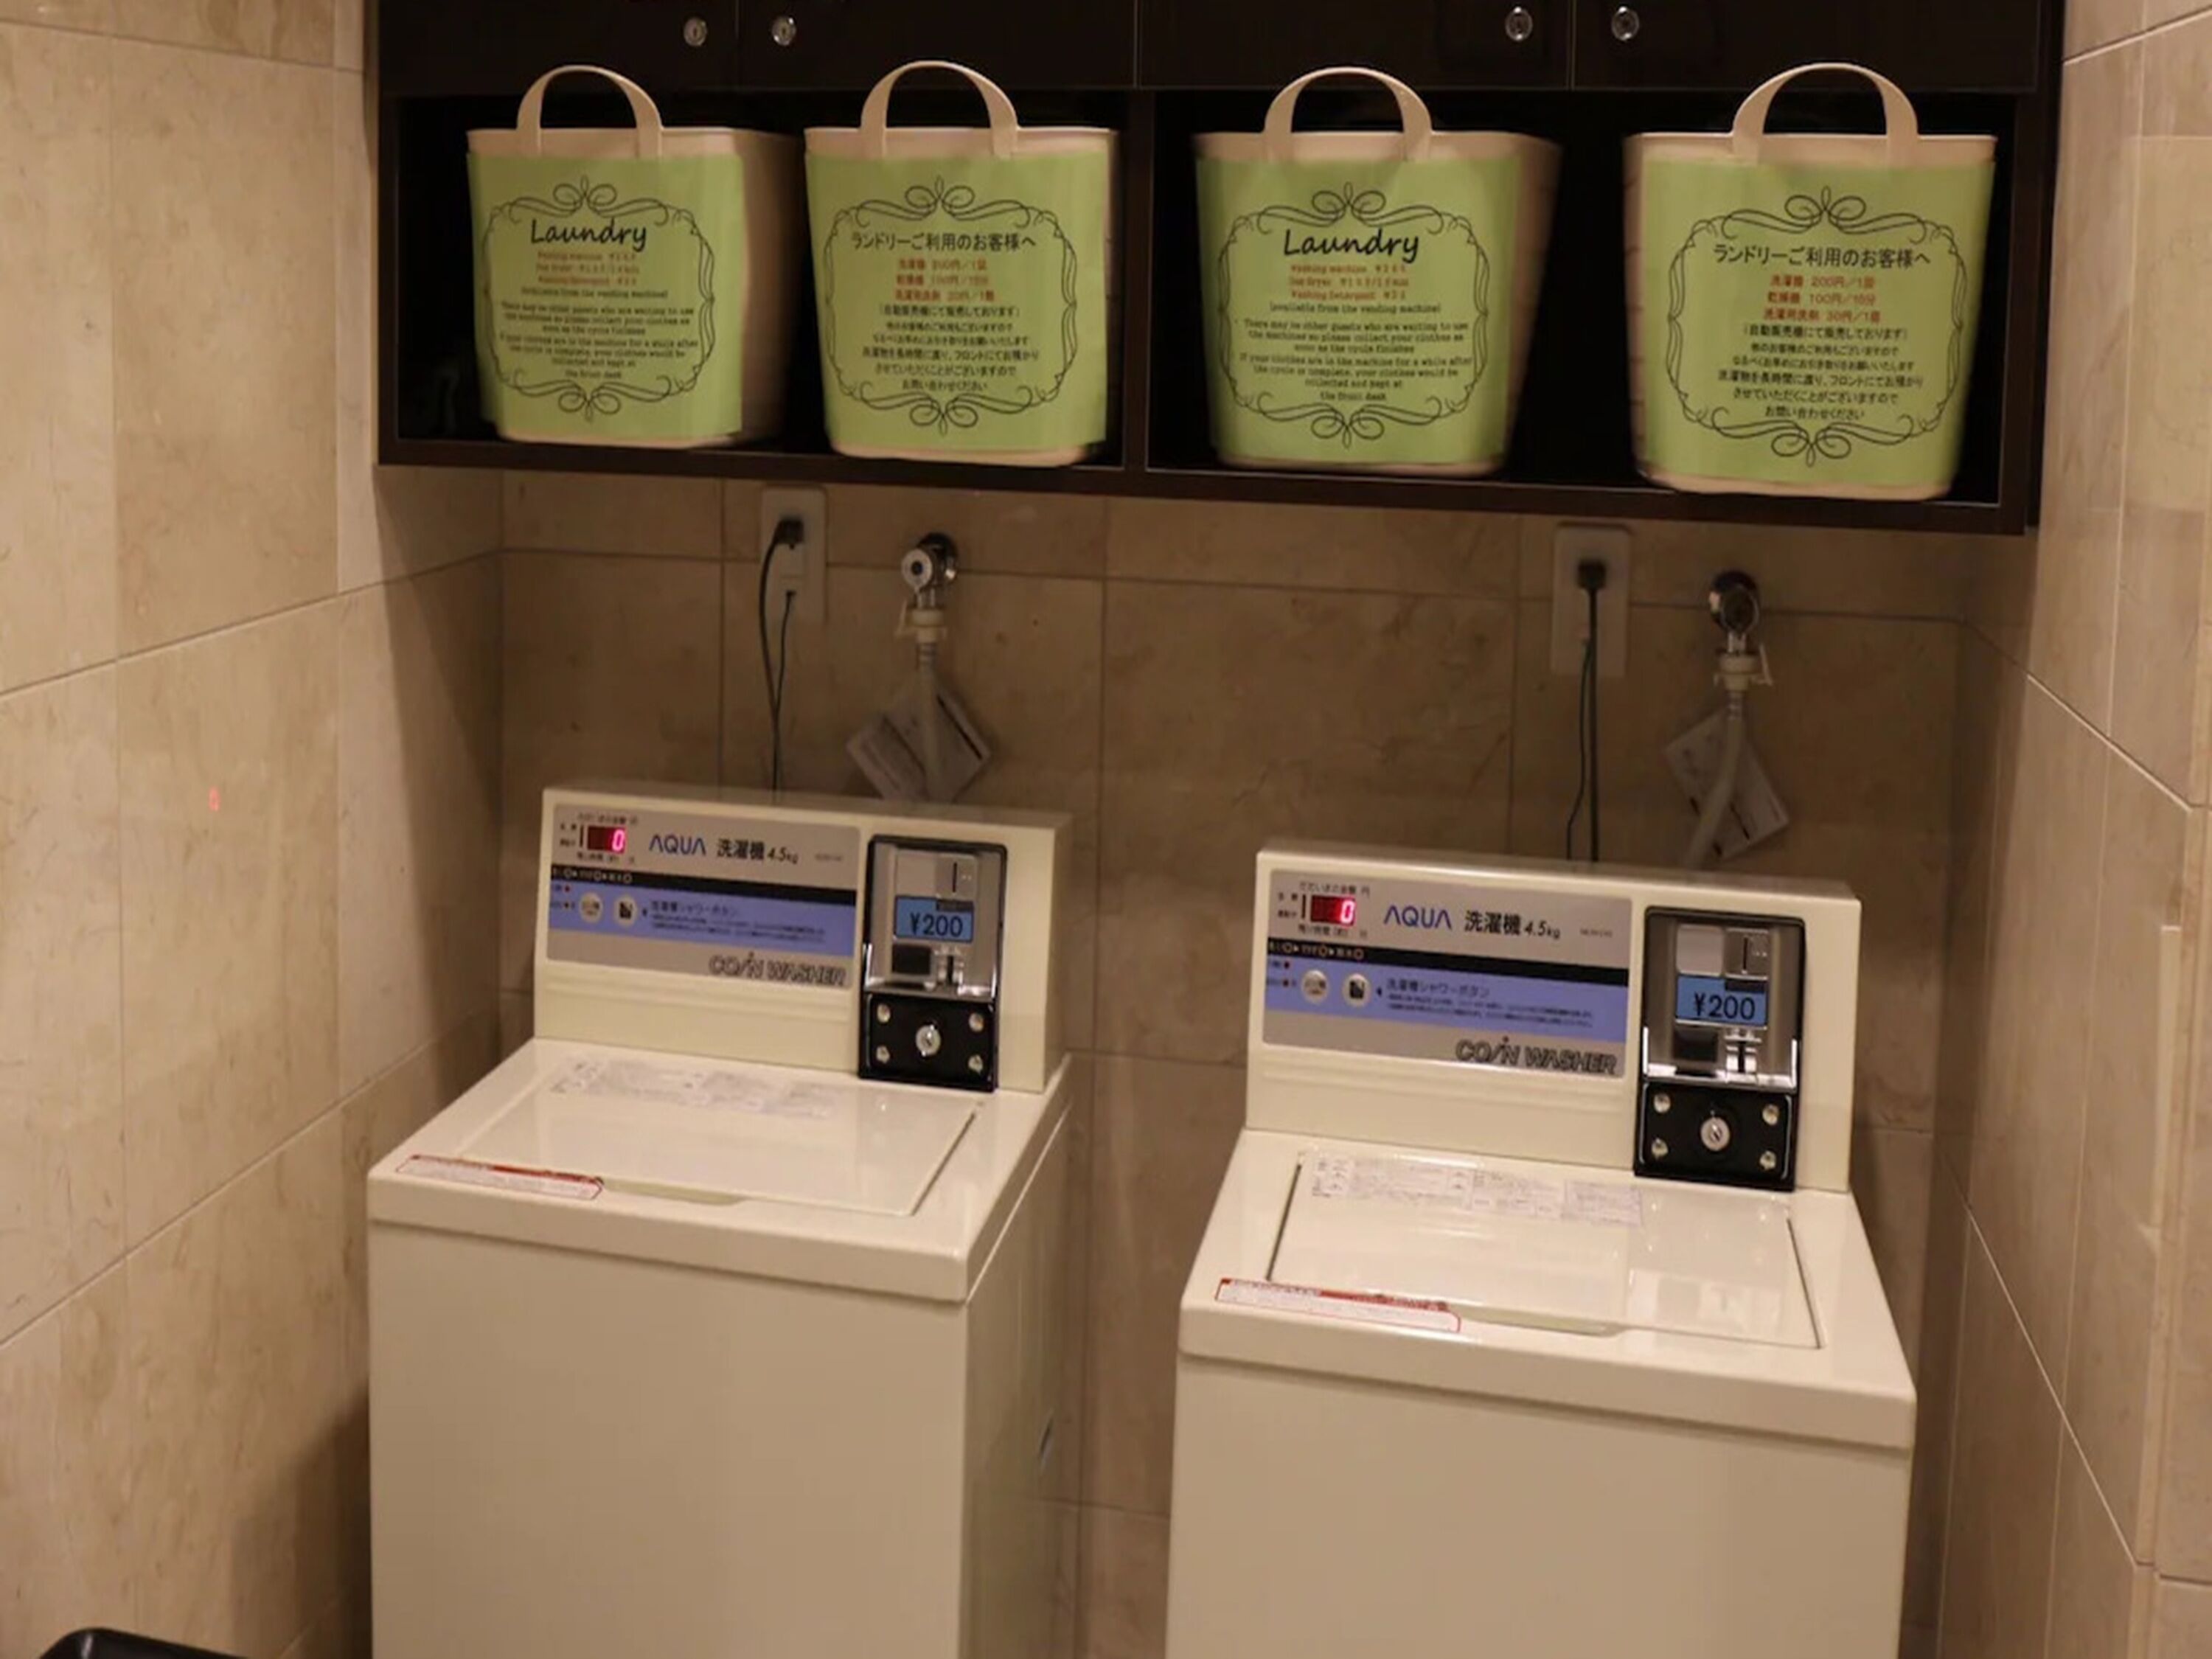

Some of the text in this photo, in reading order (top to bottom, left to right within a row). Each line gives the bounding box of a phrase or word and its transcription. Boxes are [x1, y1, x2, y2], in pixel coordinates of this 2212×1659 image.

[530, 218, 647, 252] Laundry
[852, 232, 1037, 254] ランドリーご利用のお客様へ
[1284, 228, 1419, 264] Laundry
[1713, 243, 1931, 269] ランドリーご利用のお客様へ
[612, 829, 626, 852] 0
[649, 834, 707, 856] AQUA
[717, 837, 765, 862] 洗濯機
[767, 845, 799, 866] 4.5kg
[910, 911, 963, 937] ¥200
[1340, 899, 1356, 924] 0
[1383, 905, 1561, 940] AQUA 洗濯機 4.5kg
[709, 951, 848, 987] COIN WASHER
[1694, 992, 1756, 1020] ¥200
[1455, 1035, 1619, 1075] COIN WASHER
